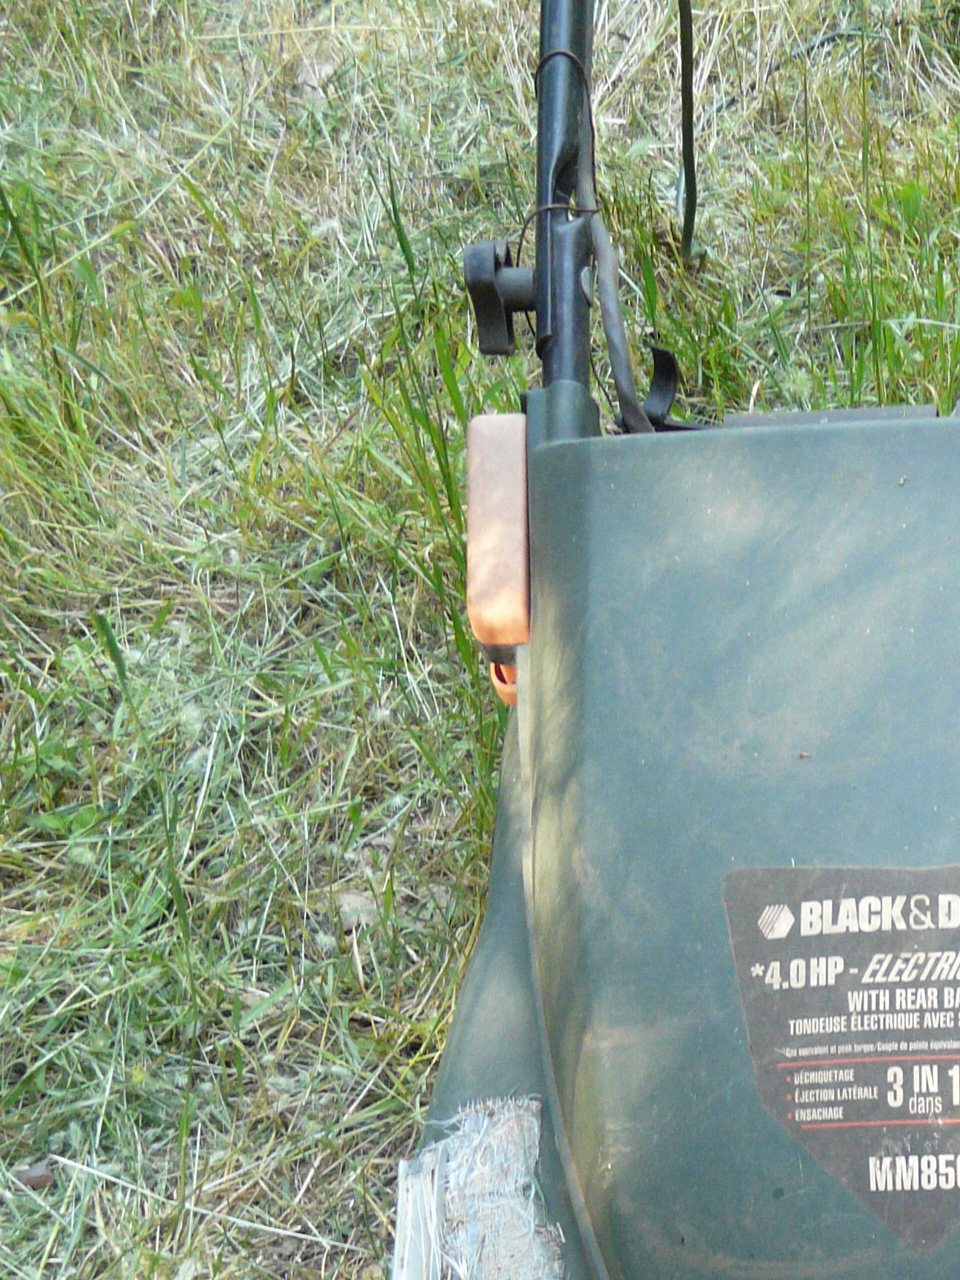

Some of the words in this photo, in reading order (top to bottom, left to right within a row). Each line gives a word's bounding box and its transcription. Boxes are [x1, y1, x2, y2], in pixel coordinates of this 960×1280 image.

[810, 956, 844, 987] HP
[847, 988, 890, 1012] WITH
[896, 987, 938, 1010] REAR
[789, 1016, 847, 1036] TONDEUSE
[851, 1011, 920, 1031] ÉLECTRIQUE
[924, 1011, 955, 1029] AVEC
[795, 1087, 835, 1104] ÉJECTION
[837, 1084, 879, 1101] LATÉRALE
[887, 1066, 904, 1108] 3
[913, 1064, 939, 1093] IN
[948, 1065, 960, 1106] 1
[795, 1107, 844, 1121] ENSACHAGE
[909, 1093, 943, 1114] dans
